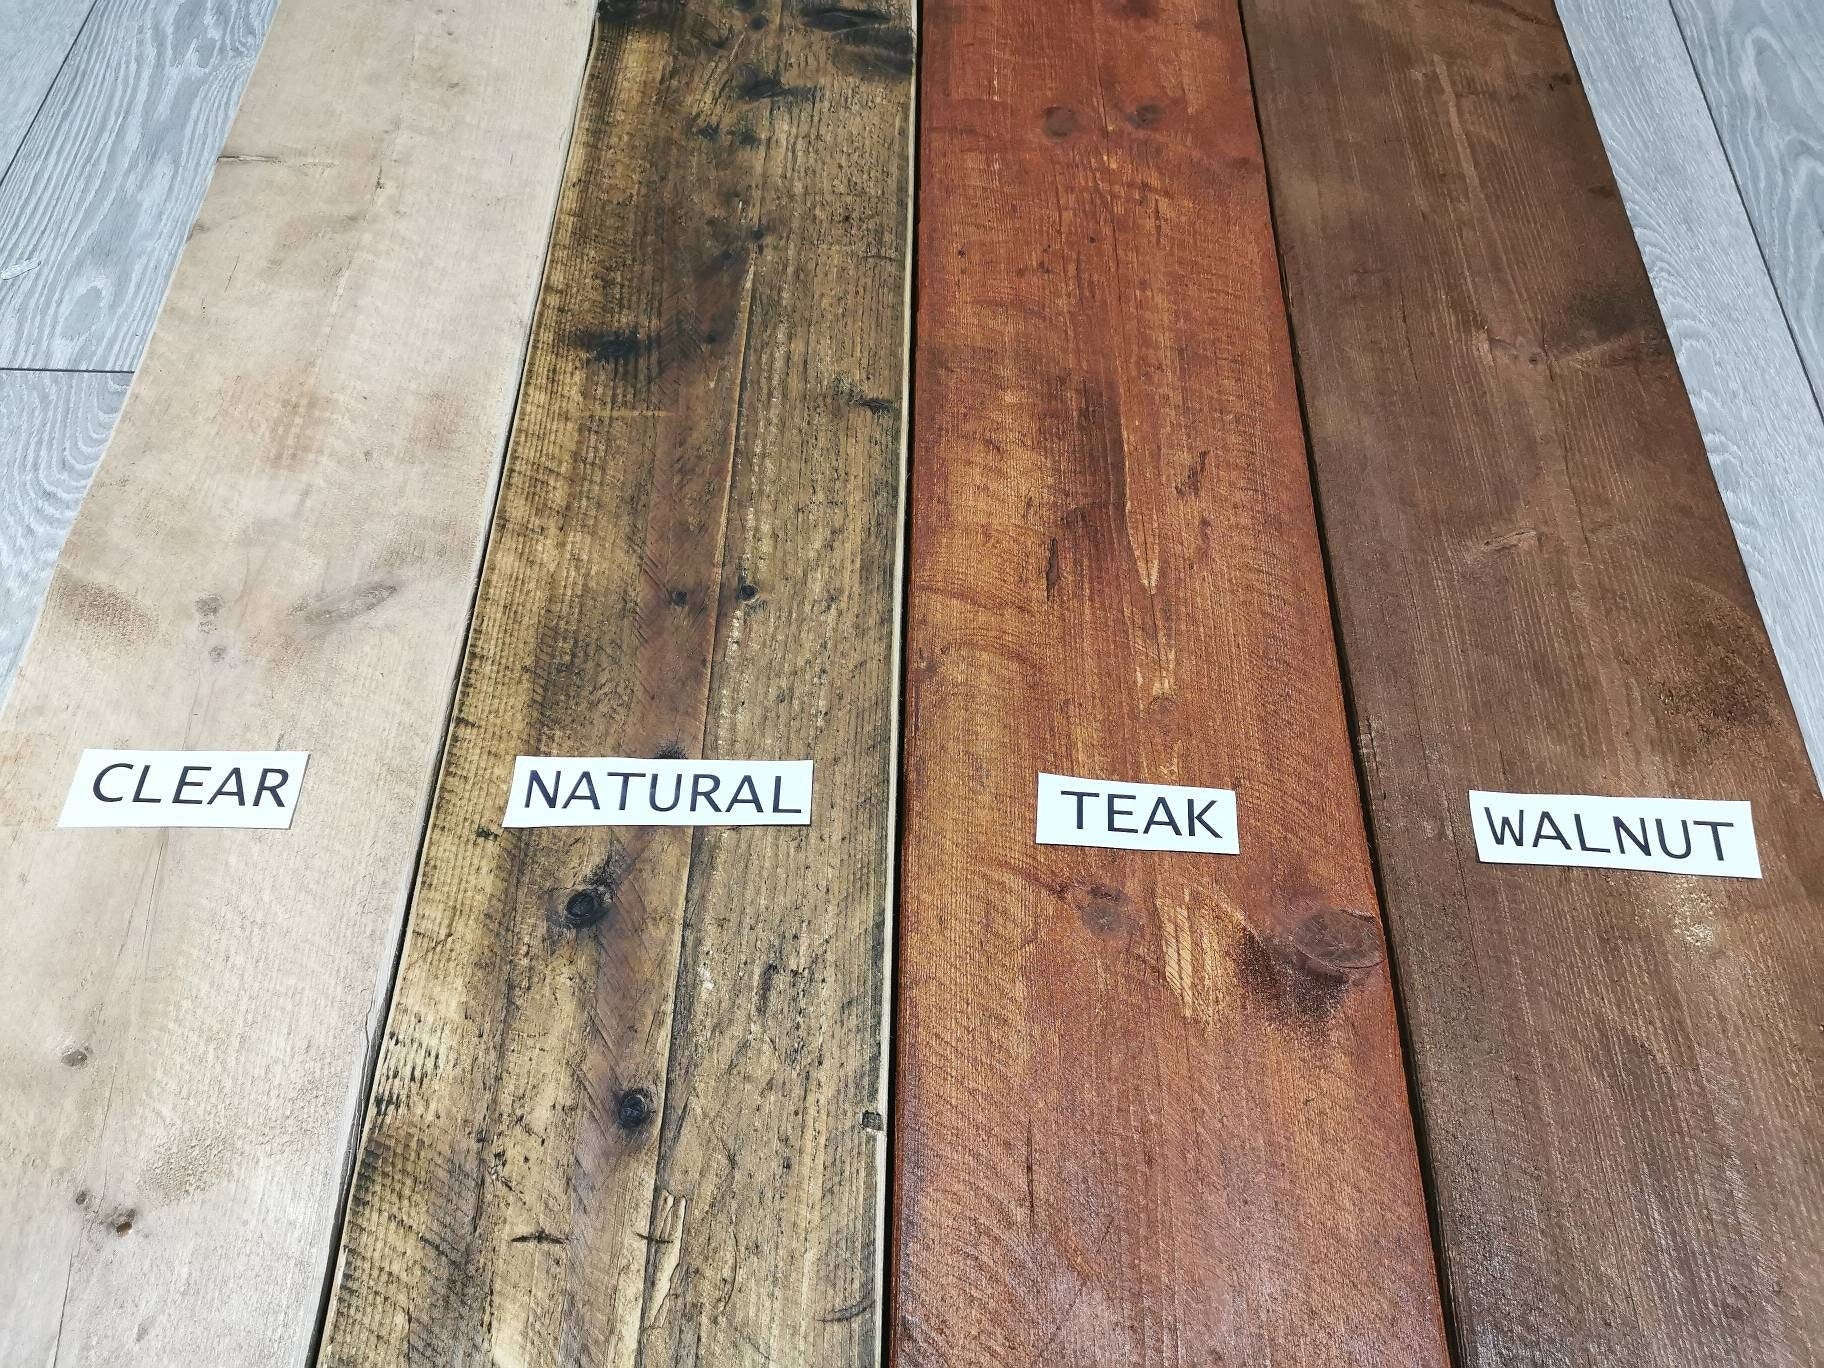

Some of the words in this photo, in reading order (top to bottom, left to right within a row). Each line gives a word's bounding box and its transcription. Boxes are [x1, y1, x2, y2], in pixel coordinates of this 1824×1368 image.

[92, 763, 288, 807] CLEAR
[525, 770, 802, 814] NATURAL
[1060, 790, 1222, 838] TEAK
[1484, 806, 1734, 861] WALNUT
